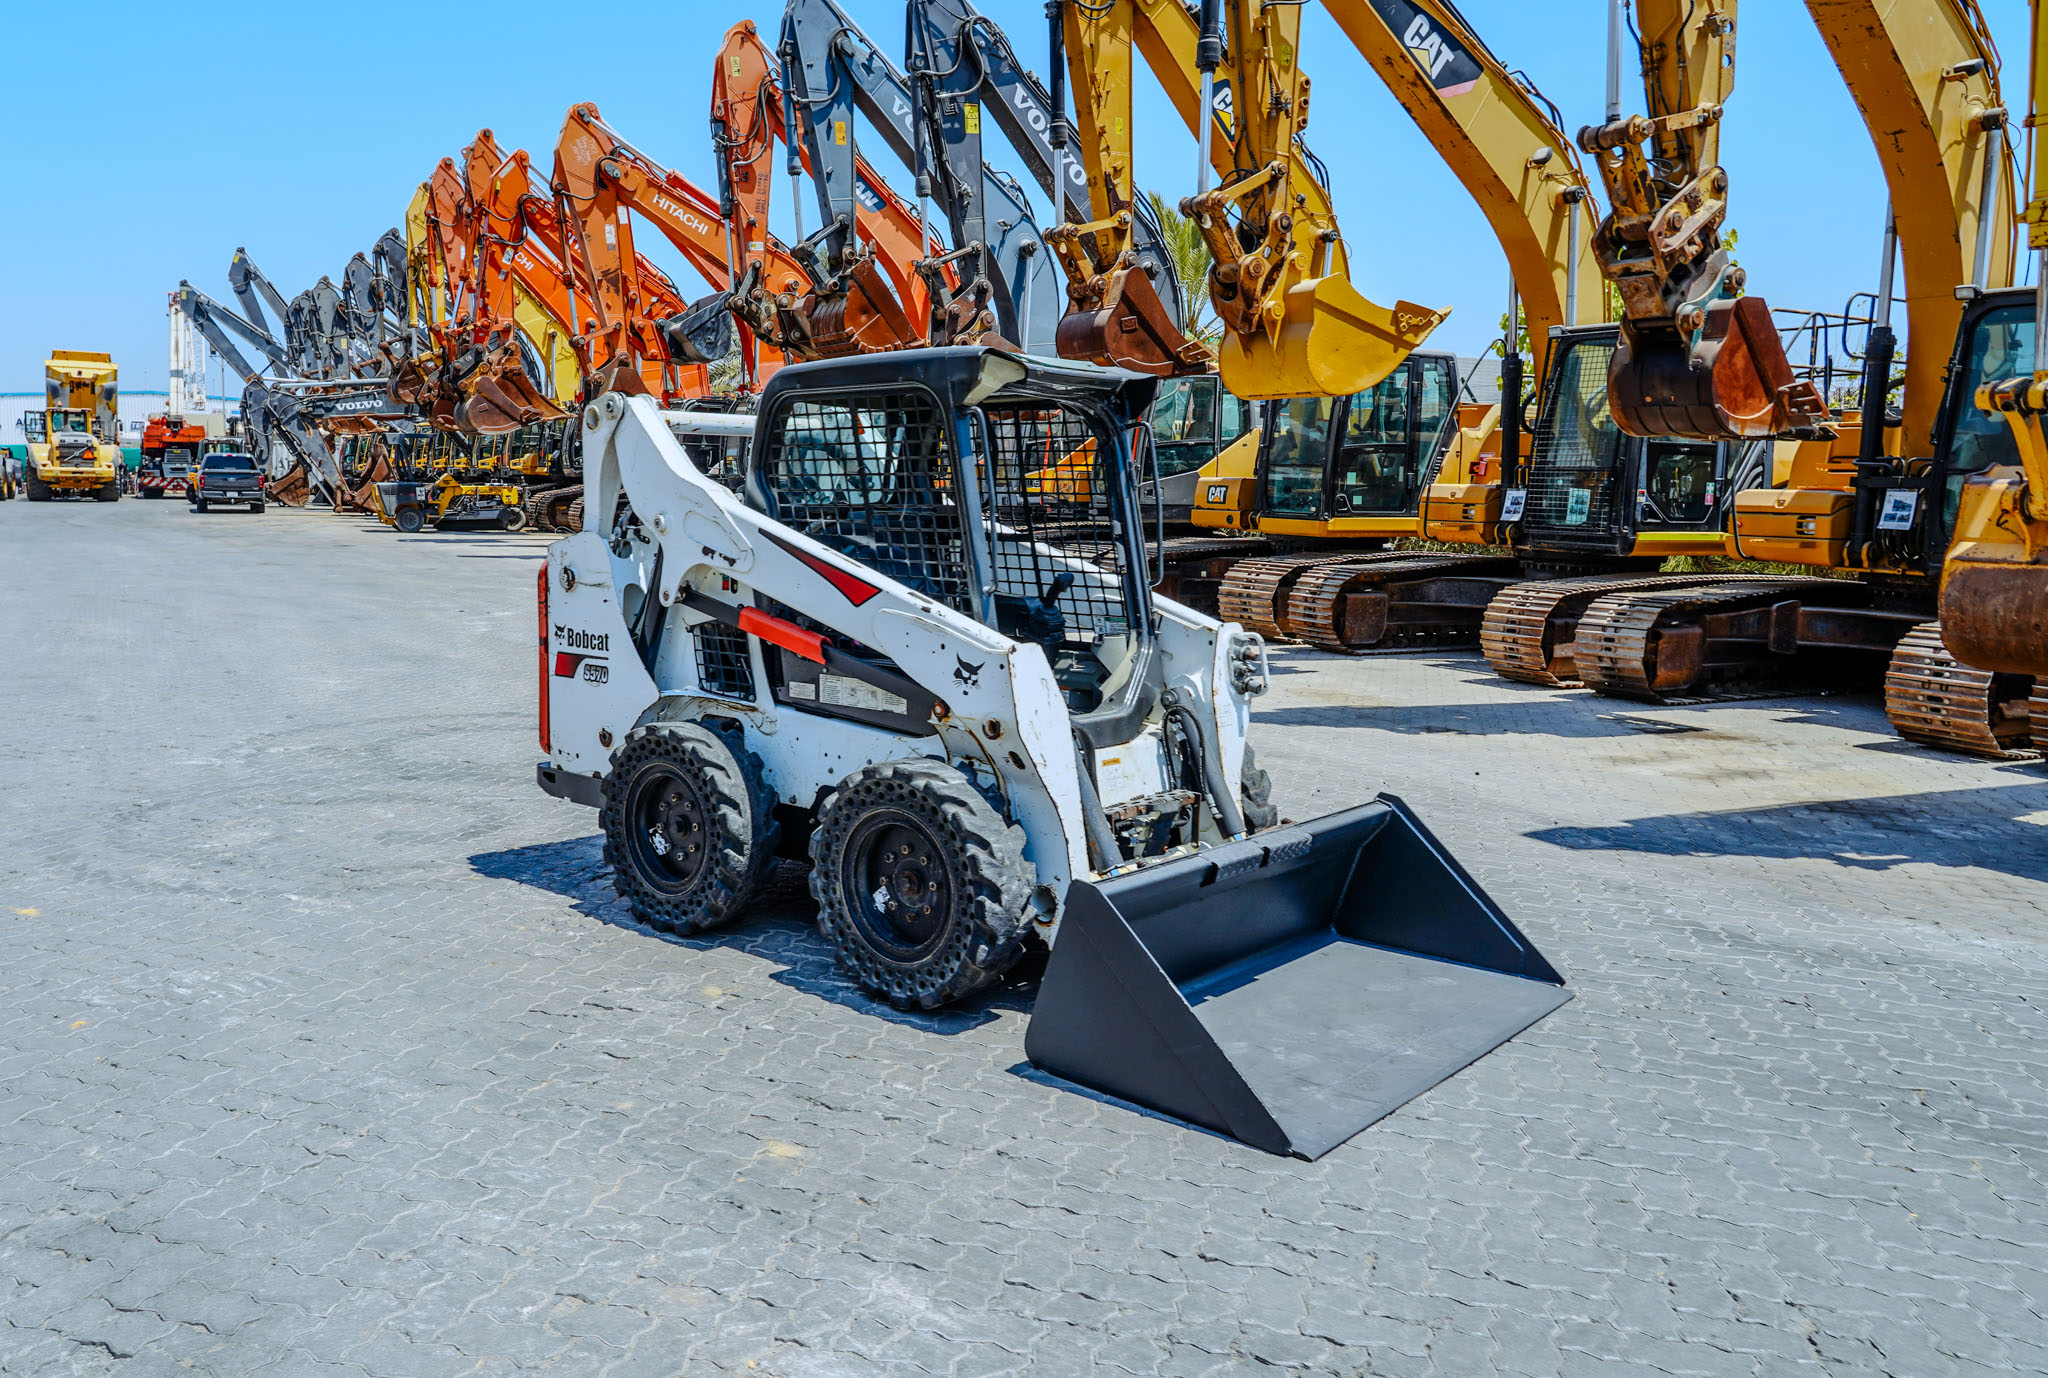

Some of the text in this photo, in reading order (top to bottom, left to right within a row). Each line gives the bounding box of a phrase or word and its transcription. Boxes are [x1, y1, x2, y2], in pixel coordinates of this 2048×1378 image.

[1403, 14, 1455, 80] CAT
[652, 193, 709, 236] HITACHI
[334, 399, 384, 411] VOLVO
[1208, 486, 1227, 503] CAT
[567, 627, 609, 652] Bobcat
[583, 663, 609, 684] S570
